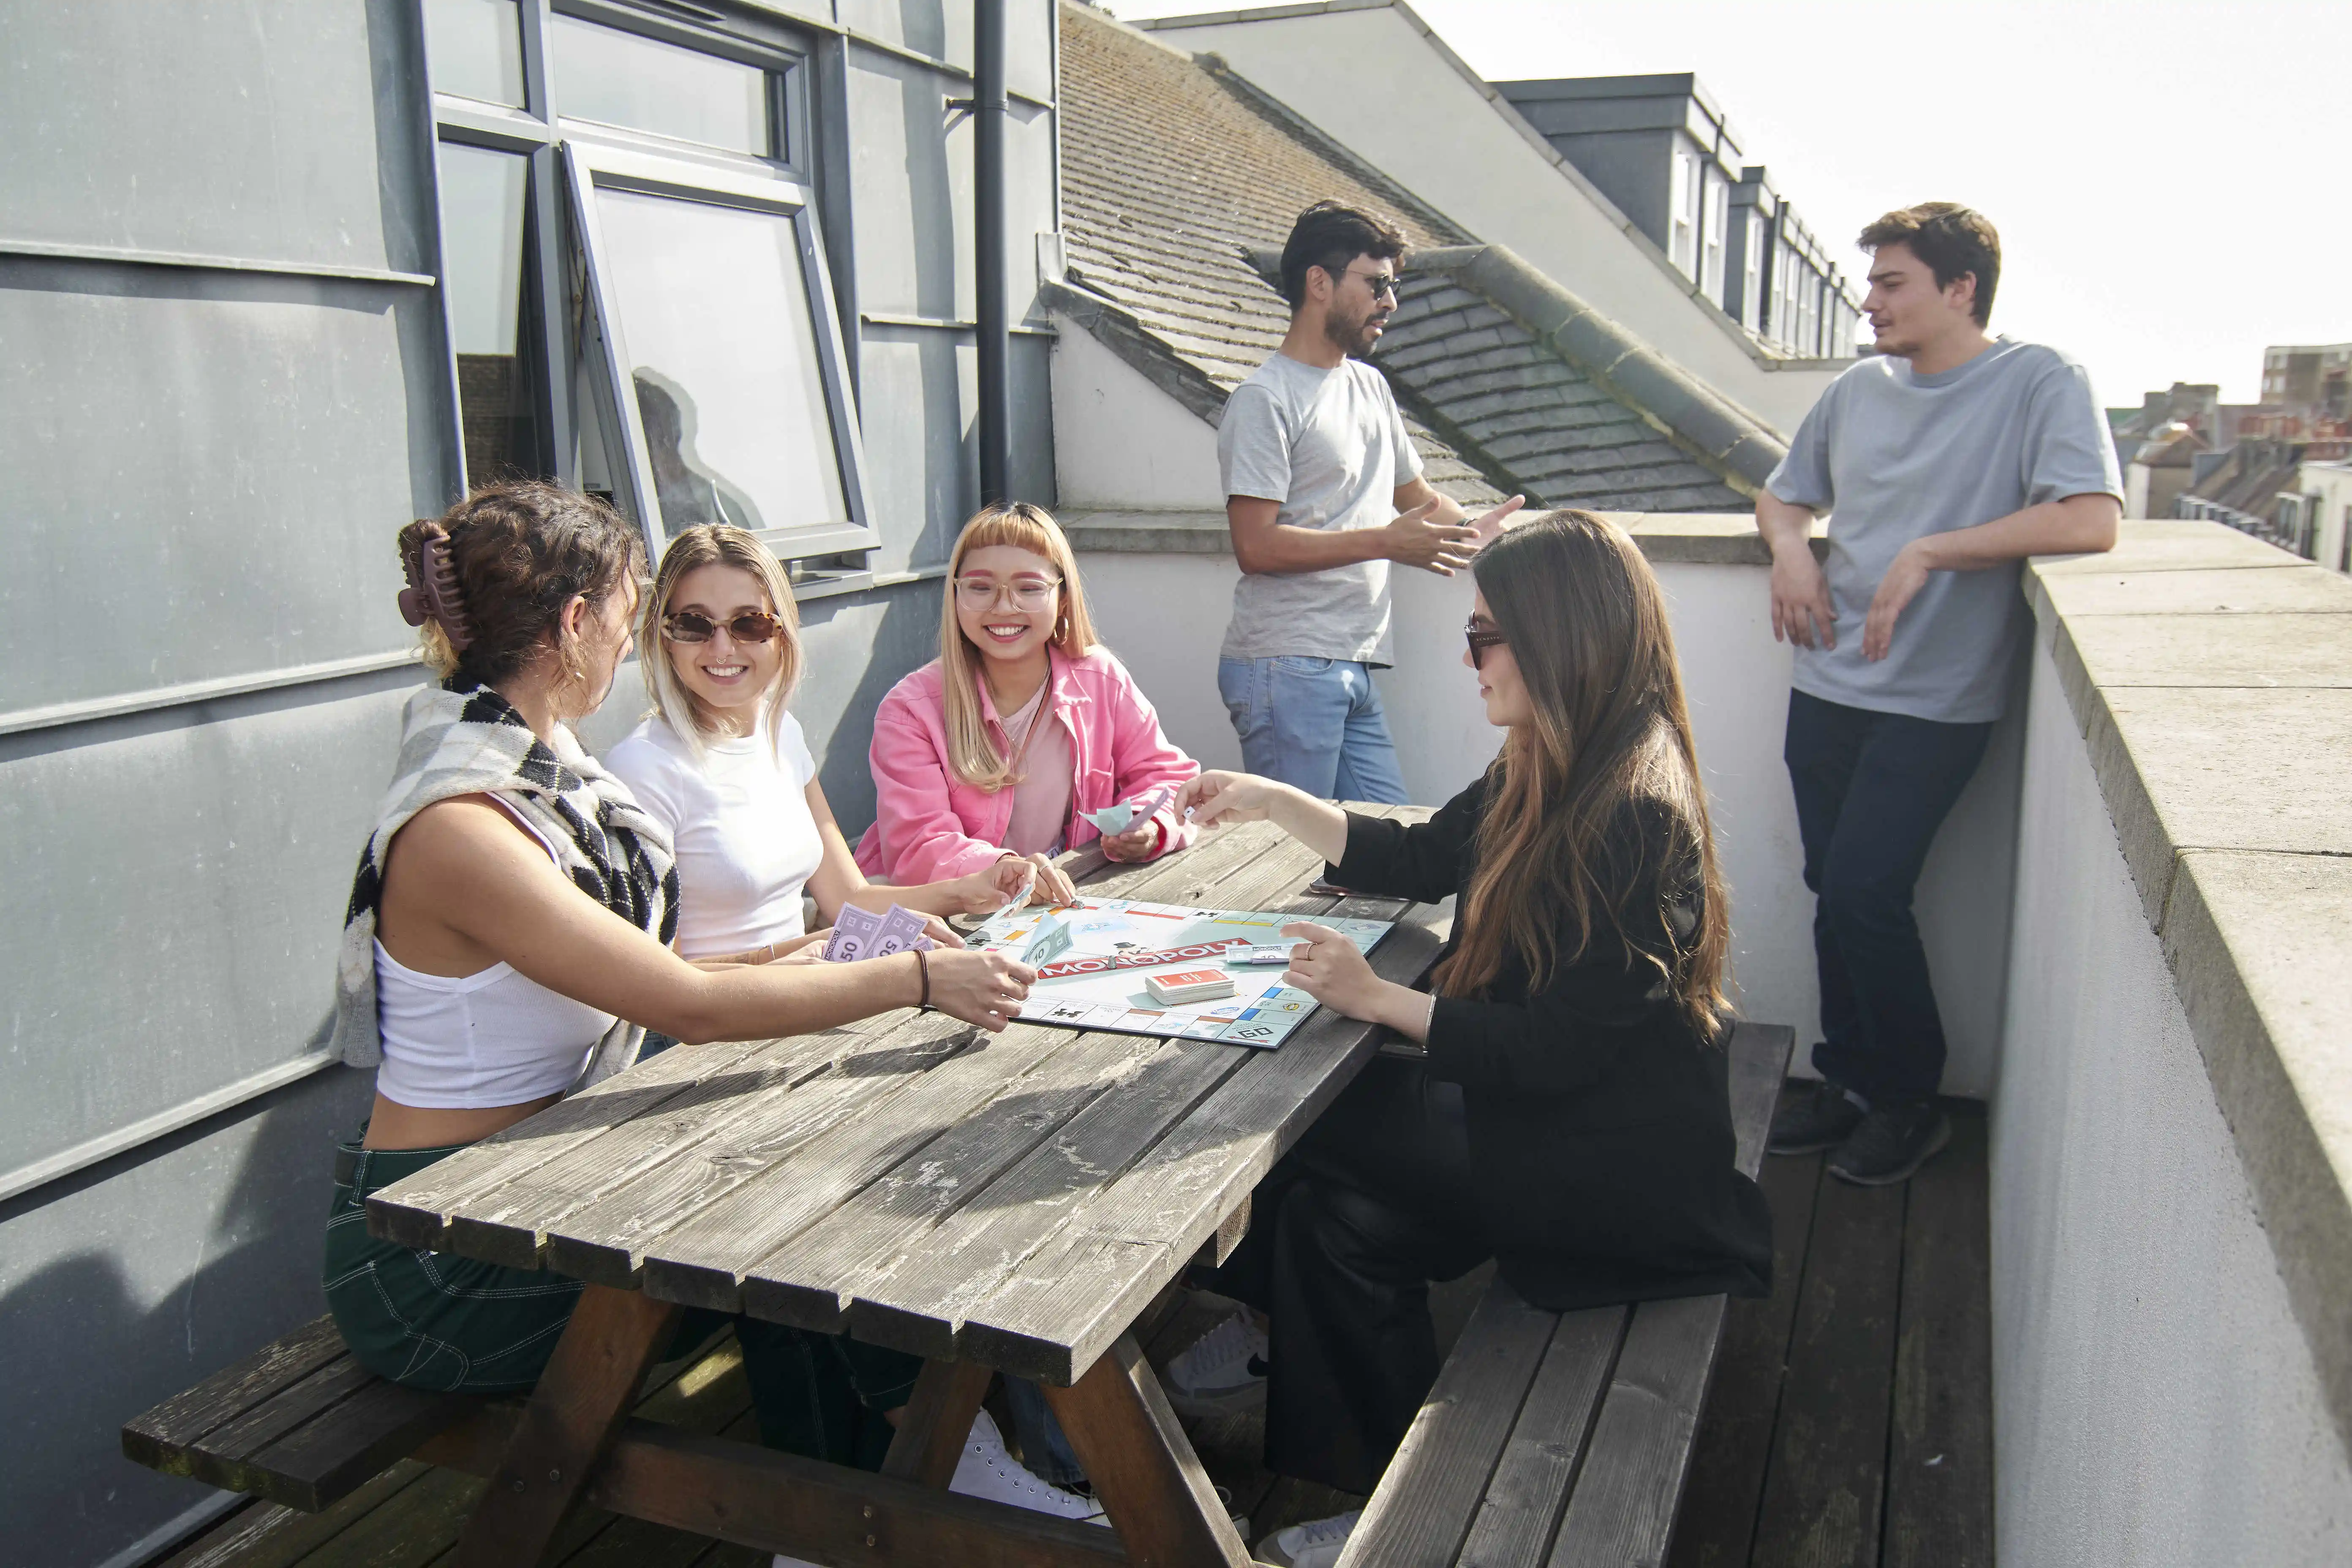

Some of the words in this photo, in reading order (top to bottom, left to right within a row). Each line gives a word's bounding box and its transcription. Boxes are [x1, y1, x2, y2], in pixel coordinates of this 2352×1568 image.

[826, 930, 840, 960] MONOPOLY
[840, 942, 858, 963] 50
[1033, 948, 1045, 964] 10
[1237, 1027, 1274, 1038] GO
